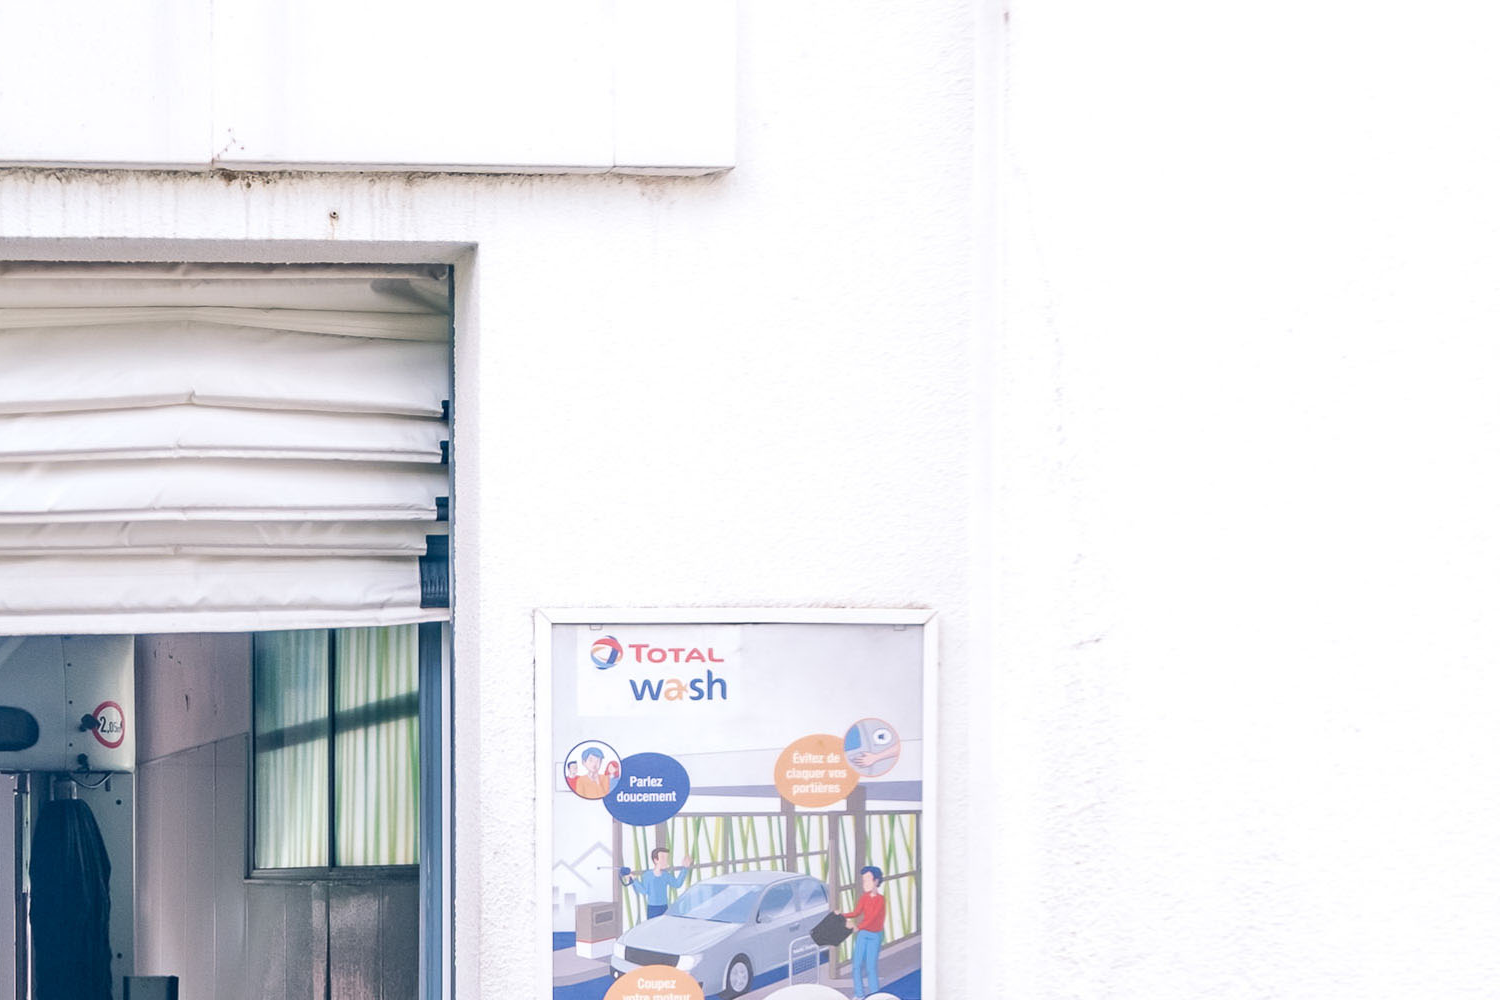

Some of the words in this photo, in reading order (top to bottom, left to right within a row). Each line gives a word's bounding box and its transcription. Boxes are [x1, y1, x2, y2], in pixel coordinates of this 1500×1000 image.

[628, 644, 725, 663] TOTAL
[629, 669, 727, 701] wash
[792, 752, 823, 764] Évitez
[826, 752, 841, 763] de
[786, 768, 825, 781] claquer
[828, 770, 847, 779] vos
[629, 776, 663, 787] Parlez
[792, 782, 841, 796] portières
[616, 791, 677, 802] doucement
[637, 978, 676, 991] Coupez
